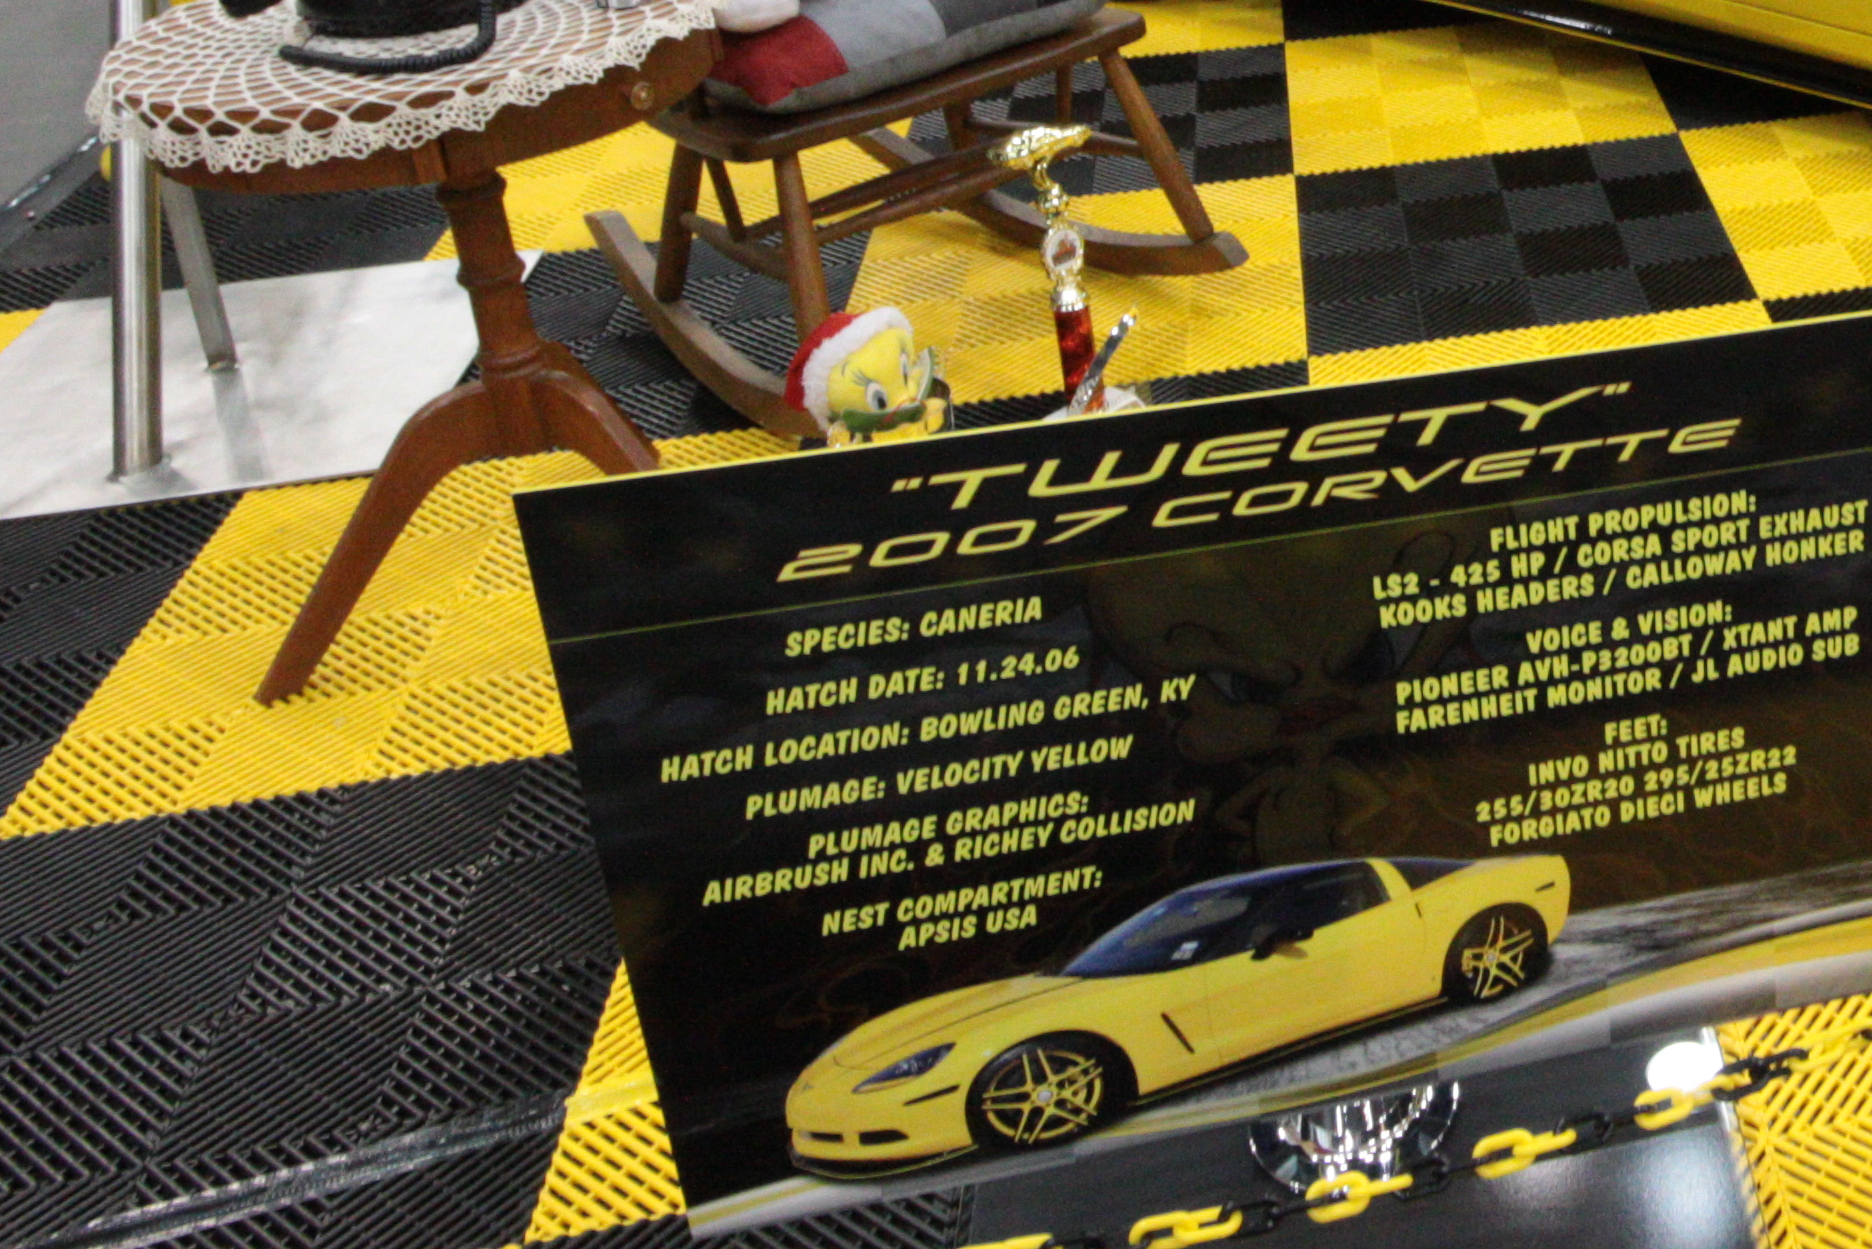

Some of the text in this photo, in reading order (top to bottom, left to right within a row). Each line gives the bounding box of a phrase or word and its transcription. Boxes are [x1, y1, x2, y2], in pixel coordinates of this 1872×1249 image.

[892, 381, 1633, 509] "TWEETY"
[777, 418, 1741, 582] 2007 CORVETTE
[1490, 489, 1756, 553] FLIGHT PROPULSION:
[1372, 572, 1420, 601] LS2
[1450, 559, 1501, 588] 425
[1510, 551, 1546, 579] HP
[1553, 546, 1568, 574] /
[1576, 533, 1662, 568] CORSA
[1671, 517, 1751, 554] SPORT
[1758, 499, 1869, 540] EXHAUST
[1379, 529, 1865, 629] KOOKS HEADERS / CALLOWAY HONKER
[784, 596, 1042, 657] SPECIES: CANERIA
[1395, 605, 1858, 706] PIONEER AVH-P3200BT / XTANT AMP
[1525, 599, 1732, 654] VOICE & VISION:
[766, 645, 1080, 715] HATCH DATE: 11.24.06
[1396, 633, 1860, 734] FARENHEIT MONITOR / JL AUDIO SUB
[661, 674, 1196, 783] HATCH LOCATION: BOWLING GREEN, KY
[1528, 726, 1745, 787] INVO NITTO TIRES
[1604, 713, 1668, 746] FEET:
[745, 734, 1134, 820] PLUMAGE: VELOCITY YELLOW
[1475, 744, 1797, 823] 255/30ZR20 295/25ZR22
[1489, 771, 1787, 848] FORGIATO DIECI WHEELS
[702, 798, 1196, 906] AIRBRUSH INC. & RICHEY COLLISION
[809, 792, 1089, 858] PLUMAGE GRAPHICS:
[822, 865, 1103, 936] NEST COMPARTMENT:
[898, 904, 1037, 951] APSIS USA
